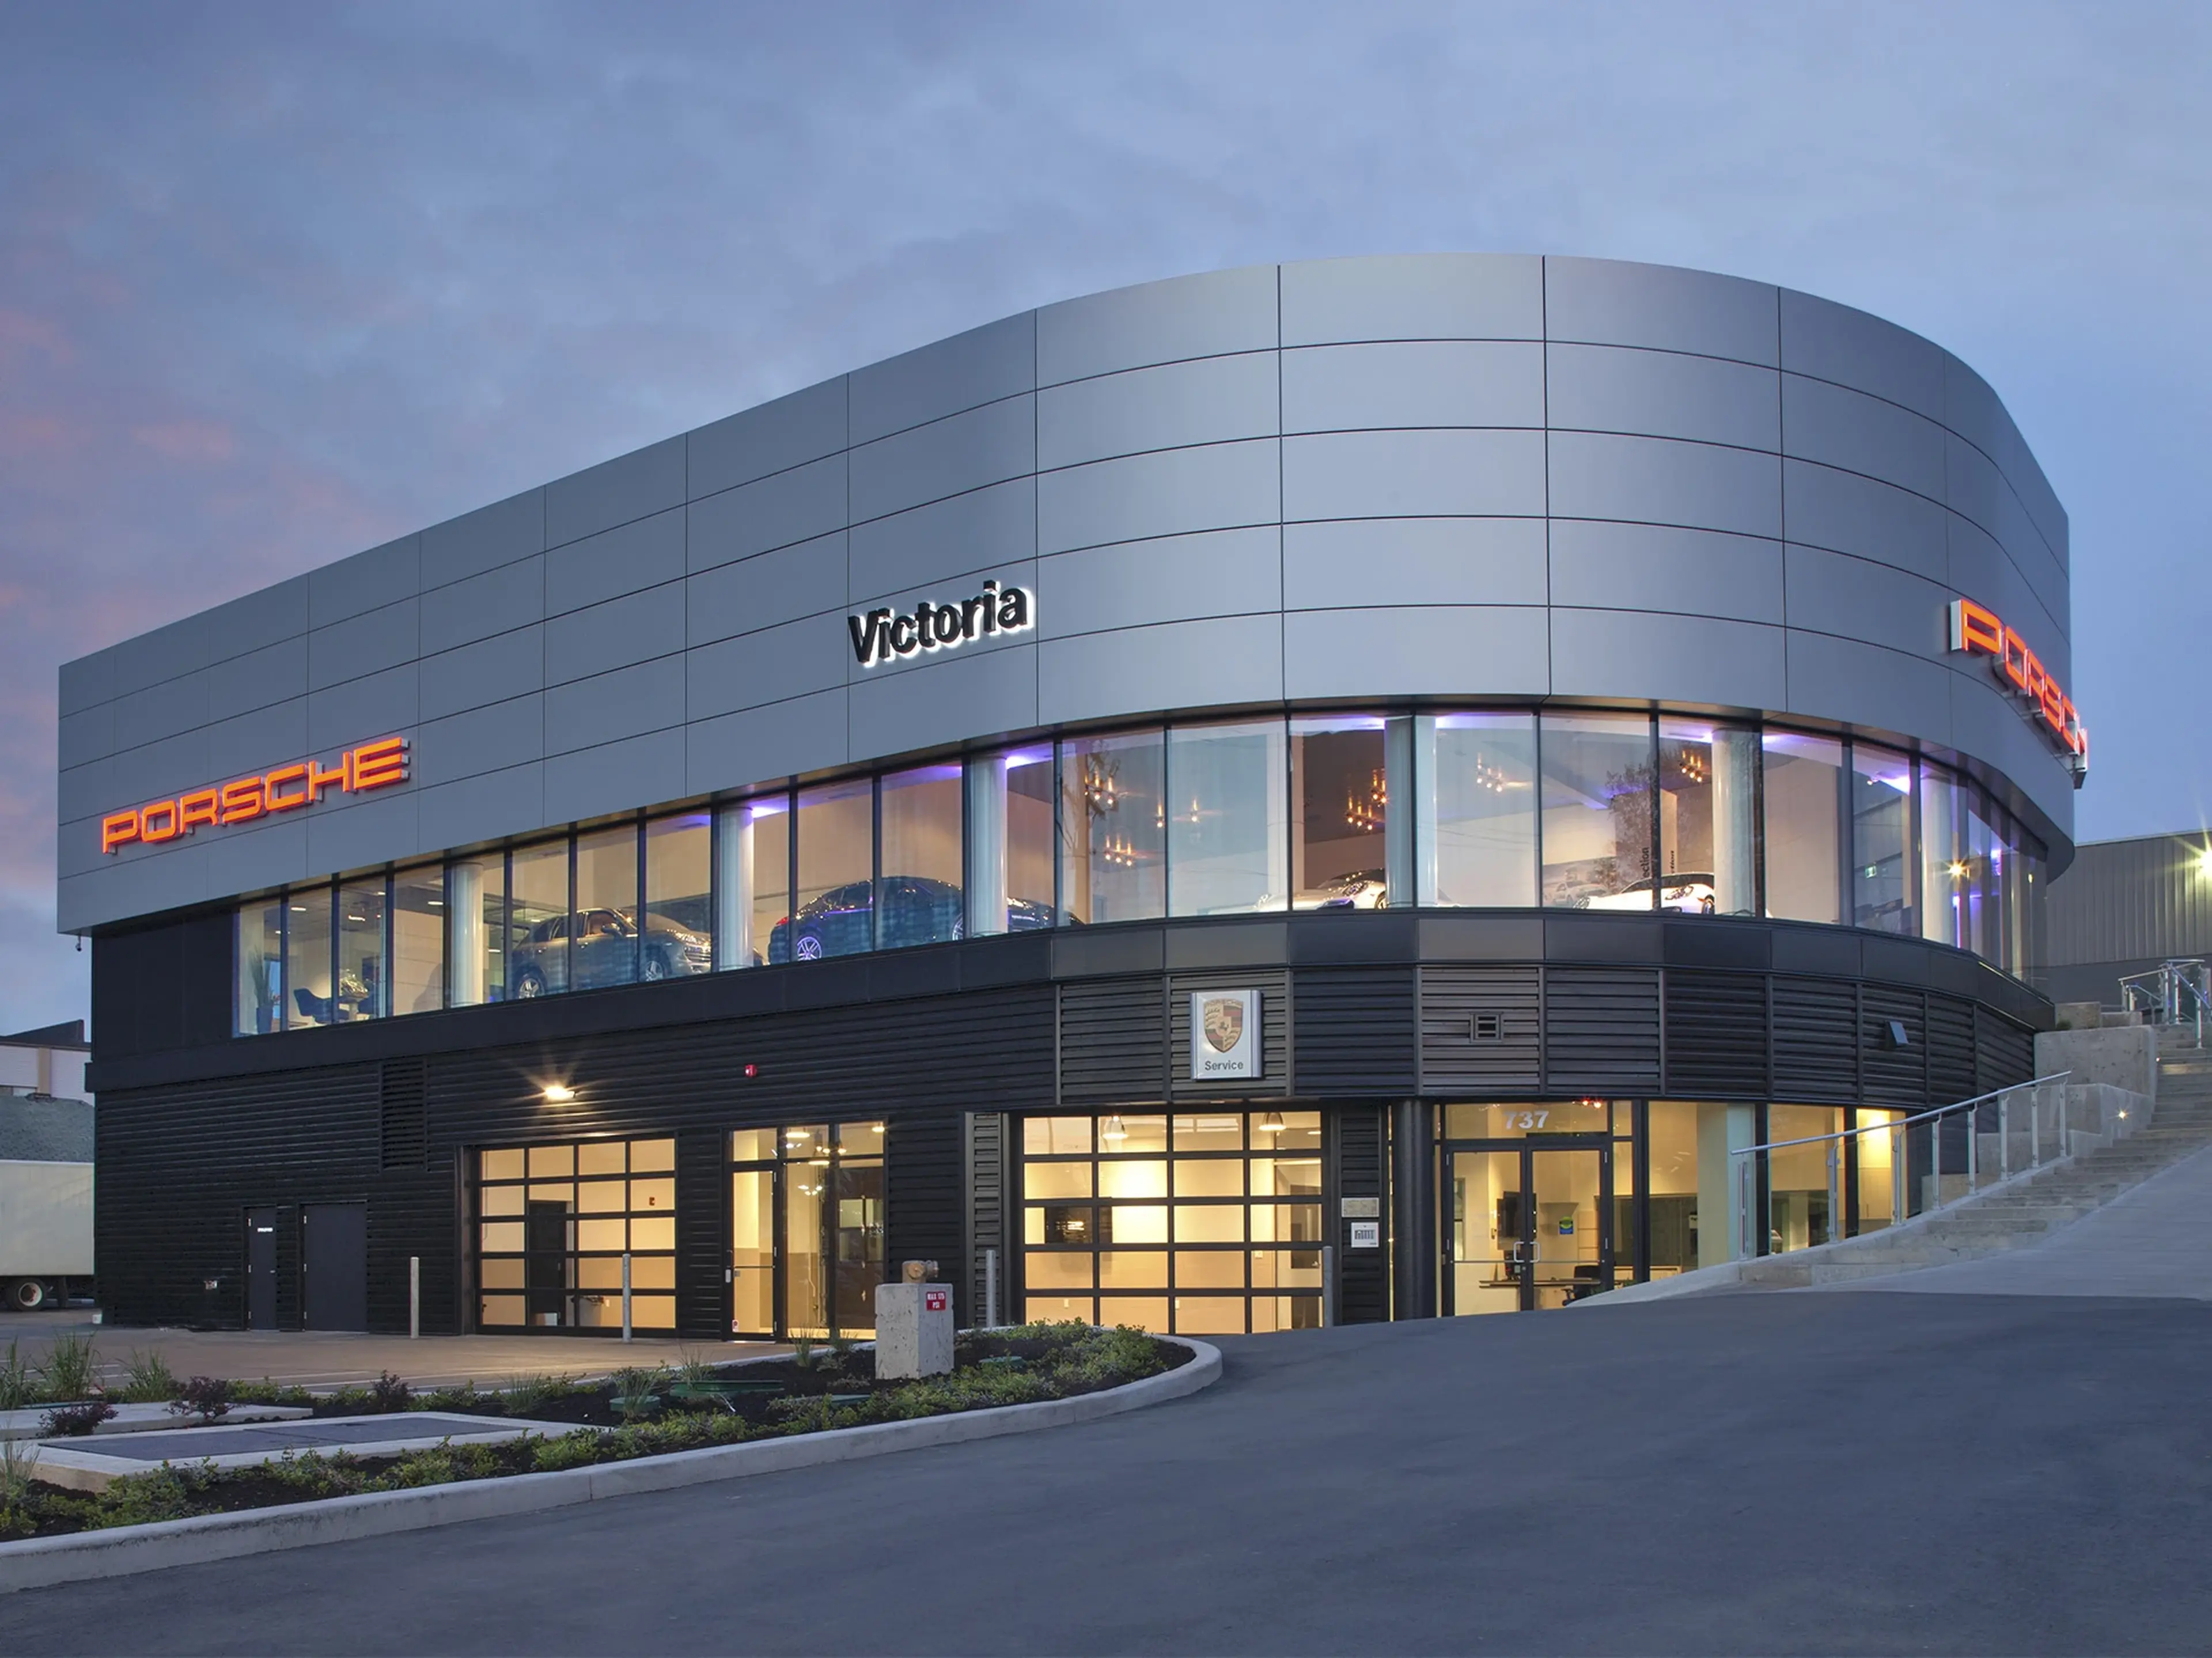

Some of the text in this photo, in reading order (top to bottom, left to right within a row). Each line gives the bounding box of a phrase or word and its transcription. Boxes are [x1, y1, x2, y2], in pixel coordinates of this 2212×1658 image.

[849, 580, 1028, 663] Victoria
[103, 737, 406, 855] PORSCHE
[1641, 847, 1650, 878] ection
[1205, 1060, 1244, 1071] Service
[1503, 1110, 1549, 1129] 737
